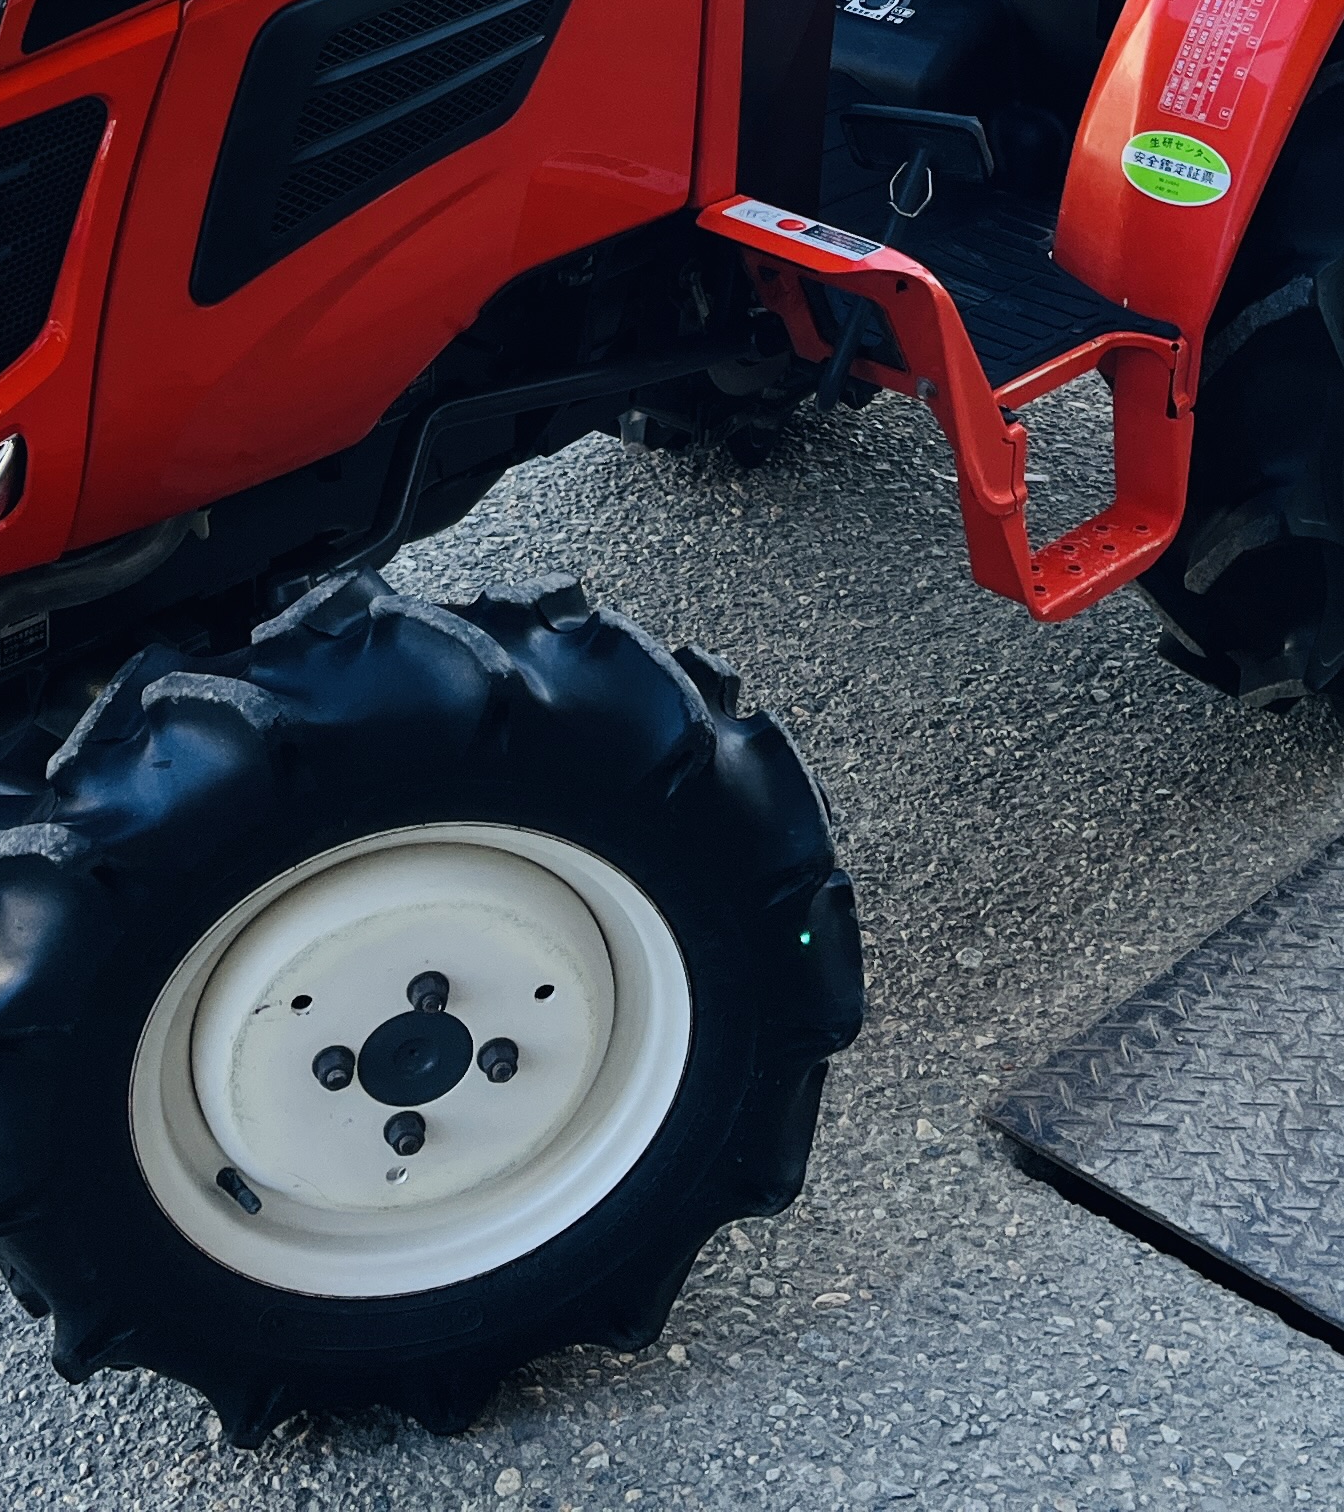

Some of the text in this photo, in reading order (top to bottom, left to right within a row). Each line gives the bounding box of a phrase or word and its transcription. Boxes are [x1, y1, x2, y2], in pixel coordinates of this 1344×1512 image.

[1150, 137, 1211, 163] 生研センター
[1134, 151, 1215, 184] 安全鑑定証票
